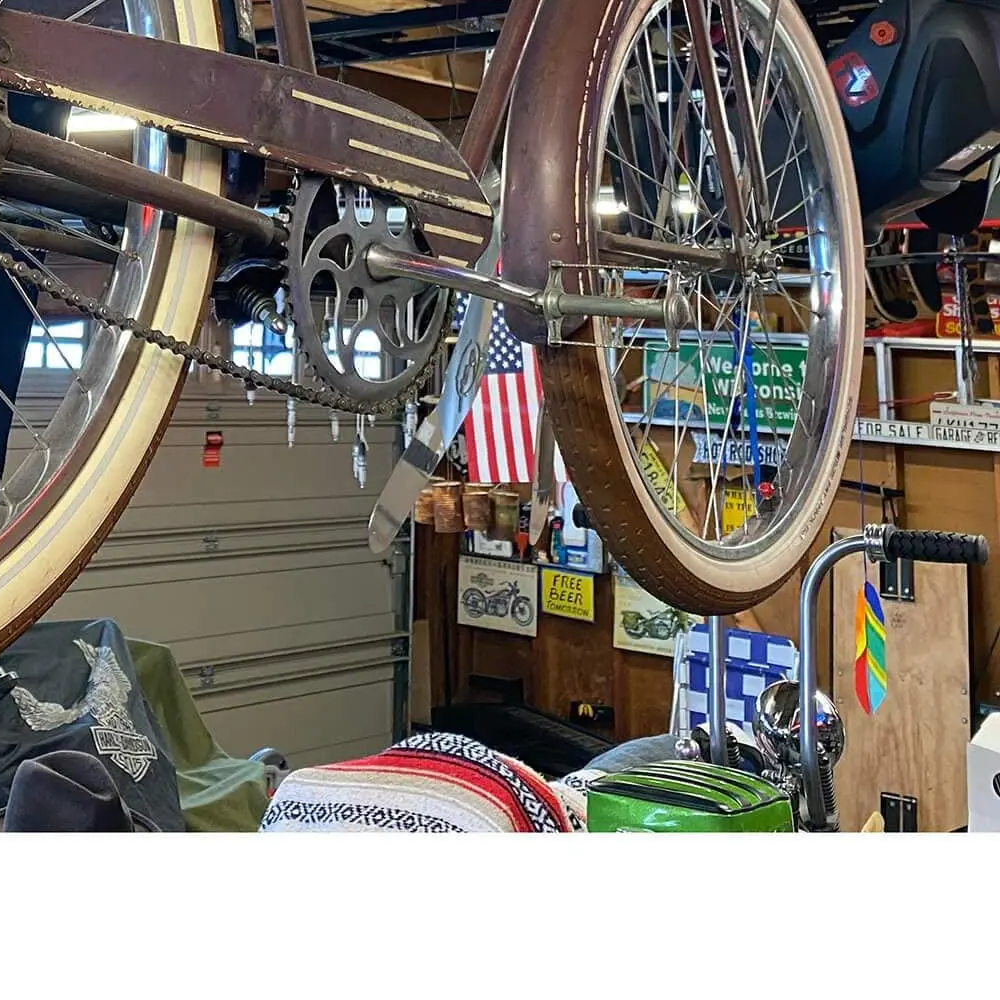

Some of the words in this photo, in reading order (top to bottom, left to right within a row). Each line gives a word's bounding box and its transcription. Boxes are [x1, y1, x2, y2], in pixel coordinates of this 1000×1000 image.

[858, 422, 882, 437] FOR
[888, 424, 924, 439] SALE
[935, 427, 972, 443] GARAGE
[552, 574, 583, 591] FREE
[549, 588, 584, 606] BEER
